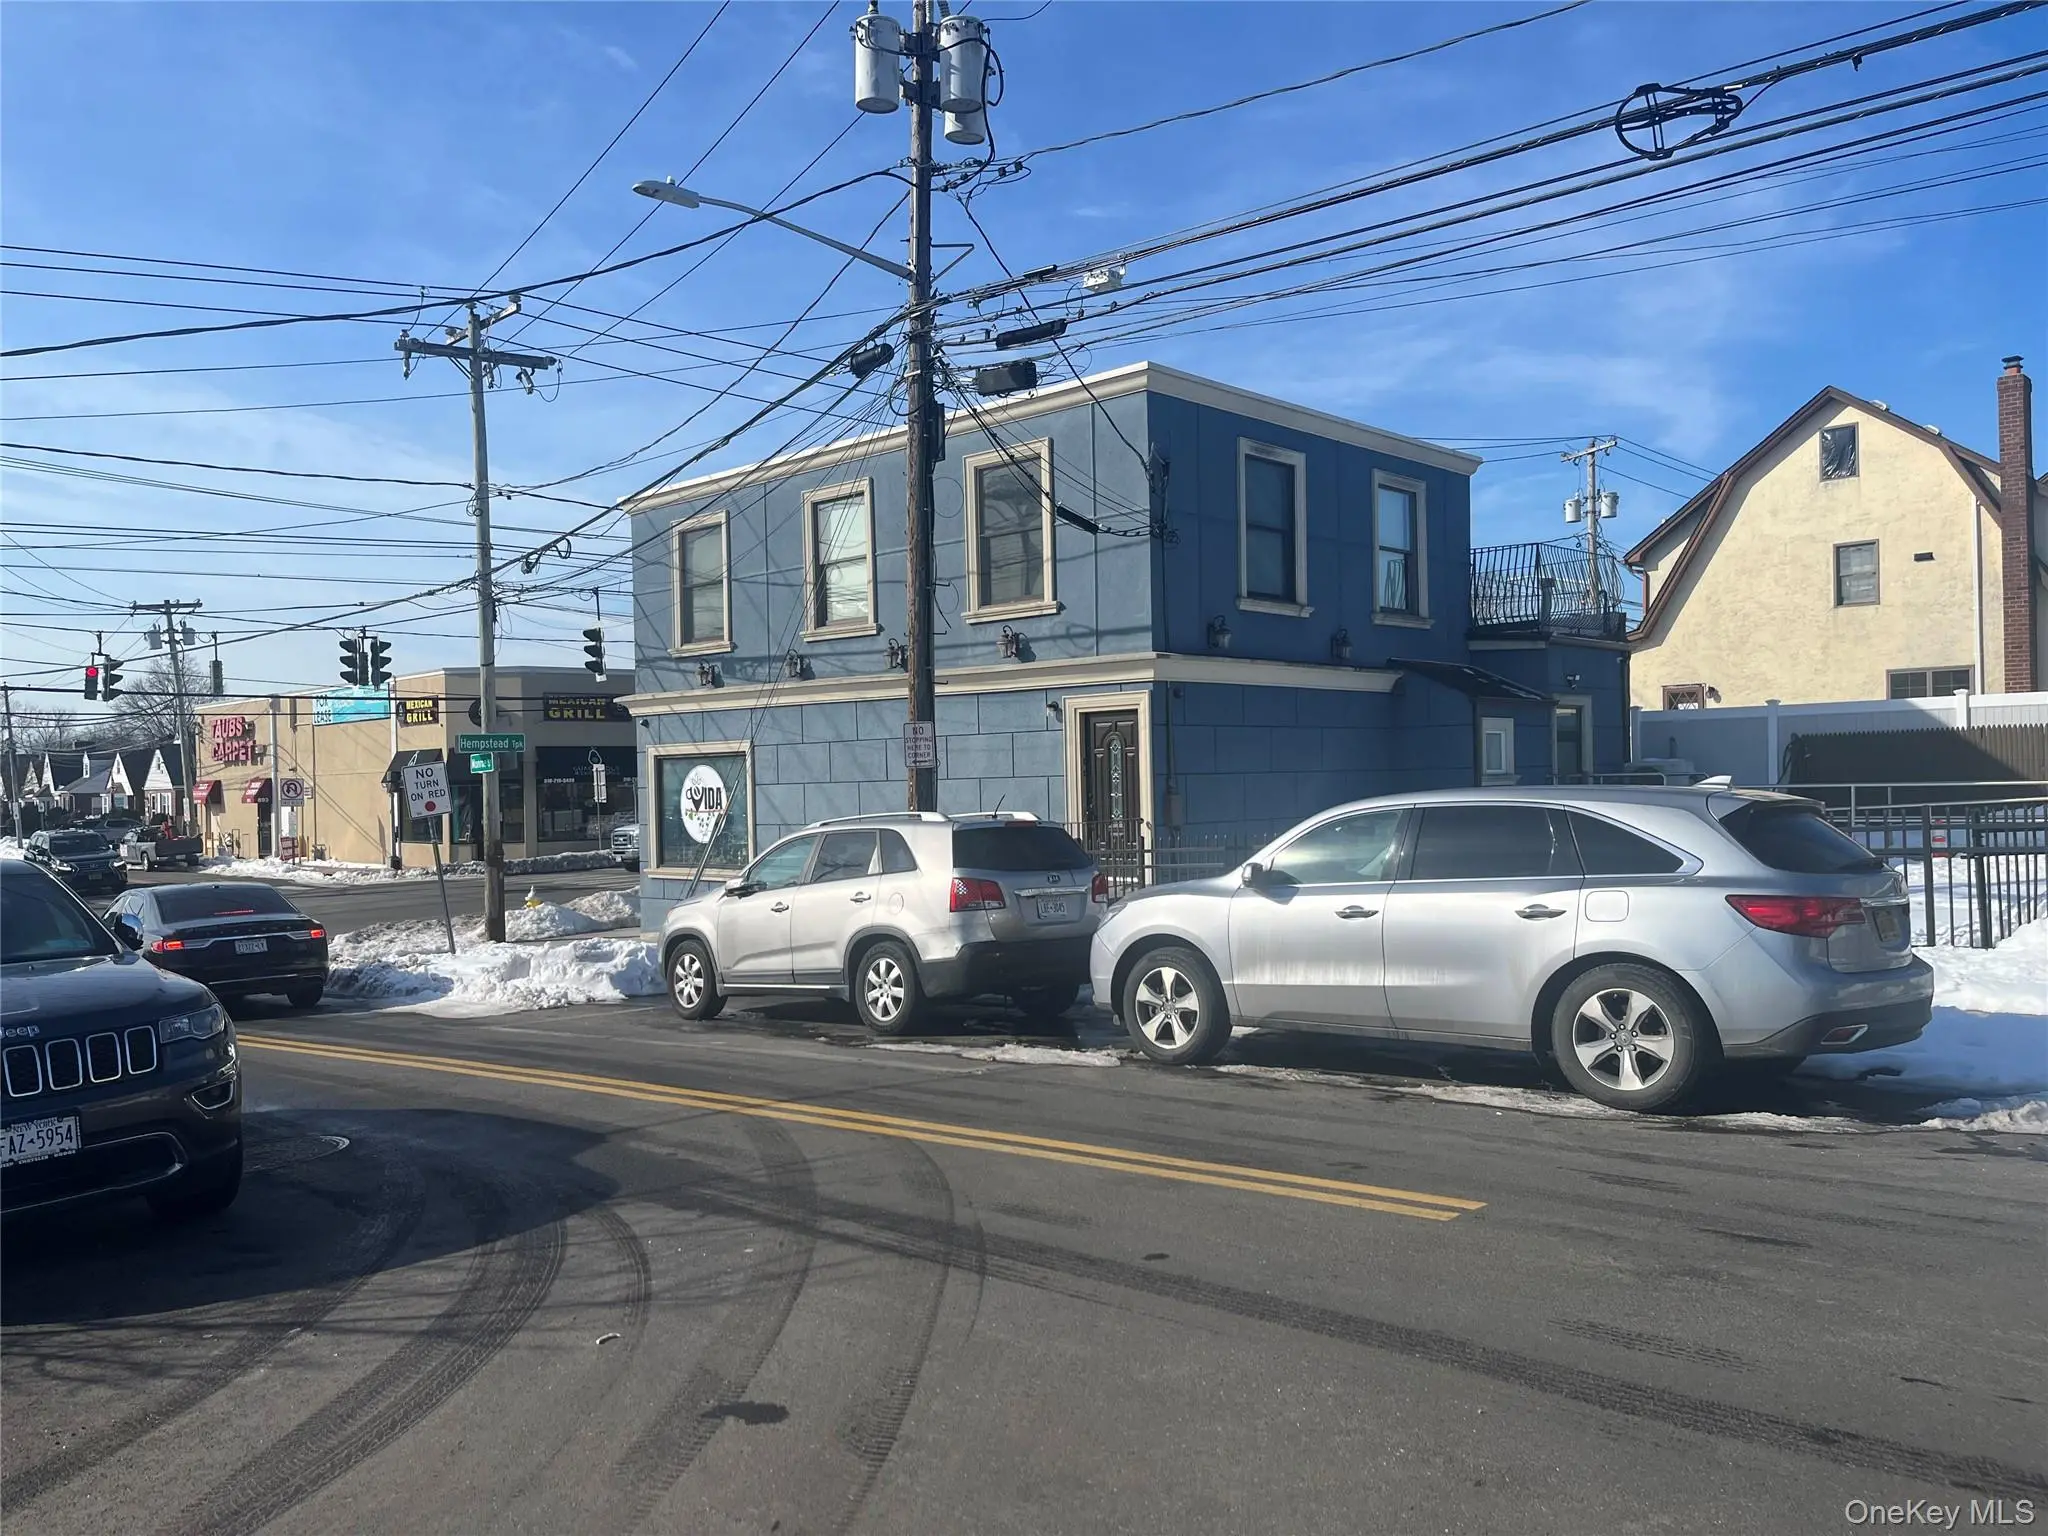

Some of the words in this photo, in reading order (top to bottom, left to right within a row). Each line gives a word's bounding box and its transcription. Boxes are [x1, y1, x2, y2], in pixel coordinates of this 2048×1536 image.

[405, 699, 433, 710] MEXICAN
[406, 710, 433, 723] GRILL
[548, 707, 606, 719] GRILL
[912, 726, 924, 736] NO
[460, 738, 509, 750] Hempstead
[512, 740, 524, 749] Tpk
[211, 740, 254, 761] CARPET
[415, 767, 434, 779] NO
[414, 779, 439, 790] TURN
[410, 792, 424, 802] ON
[428, 789, 446, 799] RED
[688, 786, 723, 813] VIDA
[36, 1124, 73, 1150] 5954
